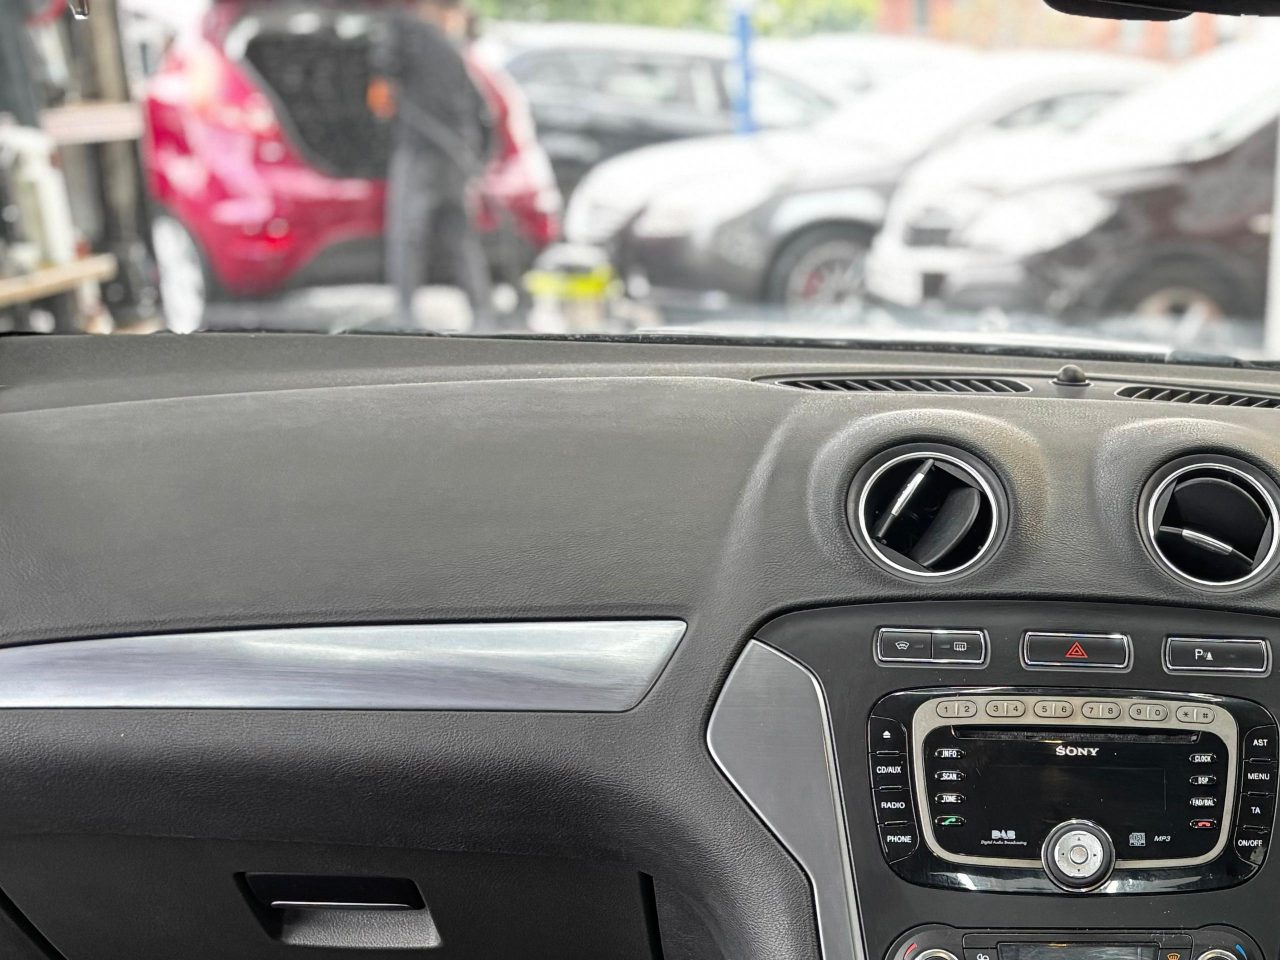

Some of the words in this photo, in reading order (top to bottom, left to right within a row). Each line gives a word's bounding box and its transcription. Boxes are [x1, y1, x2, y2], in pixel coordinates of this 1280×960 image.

[1195, 649, 1203, 660] P
[1055, 745, 1099, 756] SONY
[992, 830, 1015, 839] DAB
